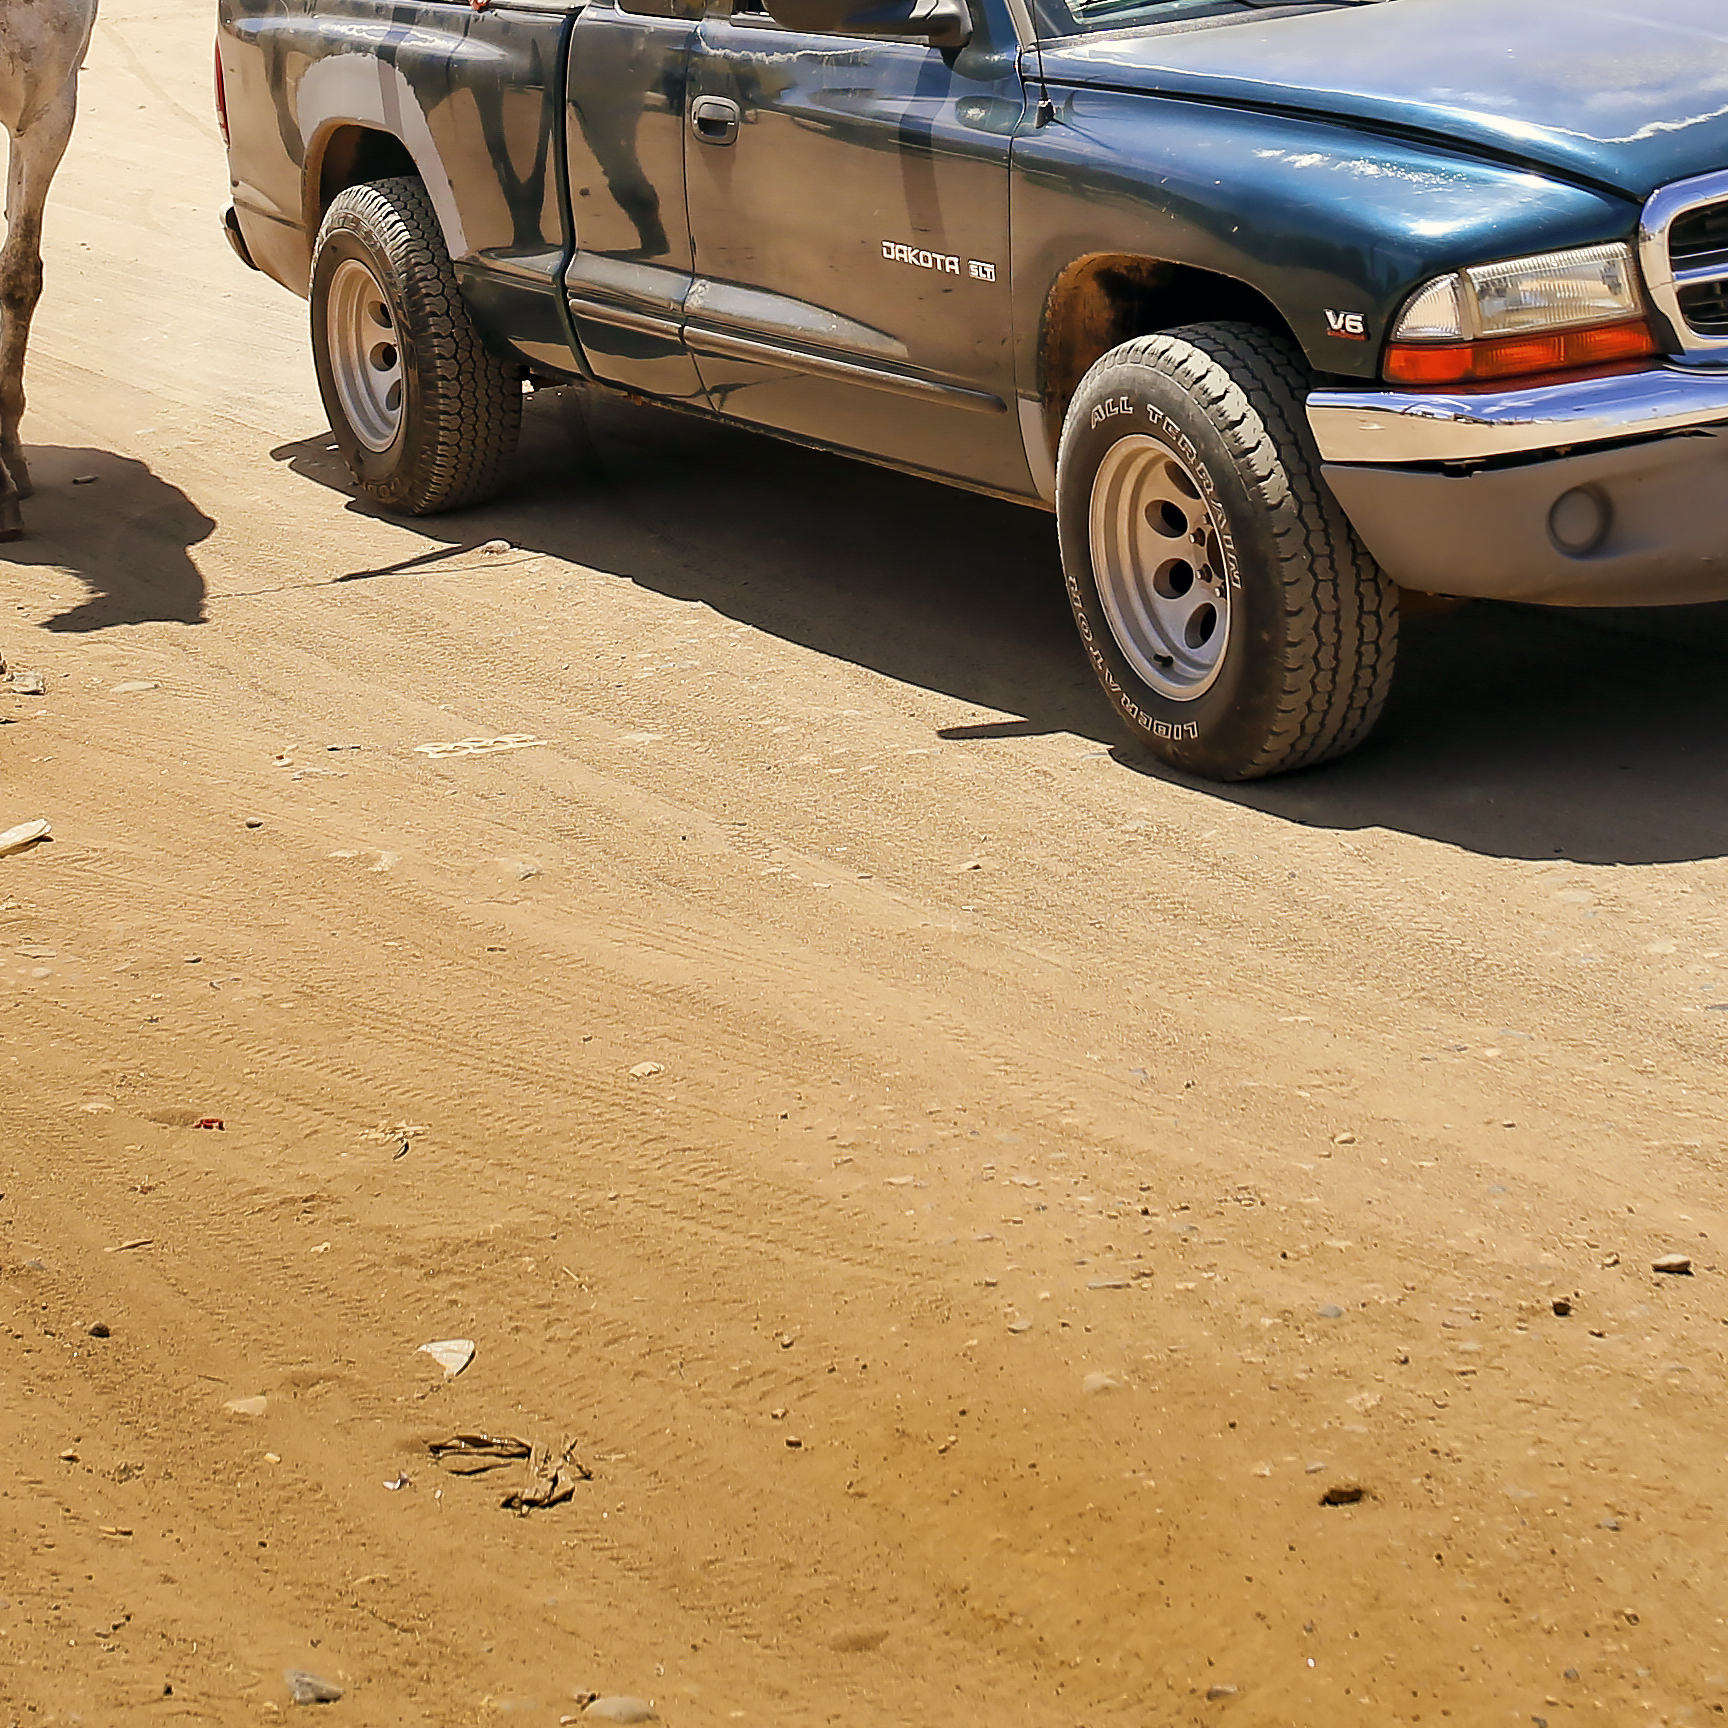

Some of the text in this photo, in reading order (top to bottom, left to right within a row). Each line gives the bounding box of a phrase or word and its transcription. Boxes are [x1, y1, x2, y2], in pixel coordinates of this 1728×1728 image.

[881, 239, 996, 282] DAKOTA SLT
[1323, 308, 1366, 334] V6
[1090, 395, 1243, 591] ALL TERRAIN
[1066, 574, 1200, 742] LIBERATOR
